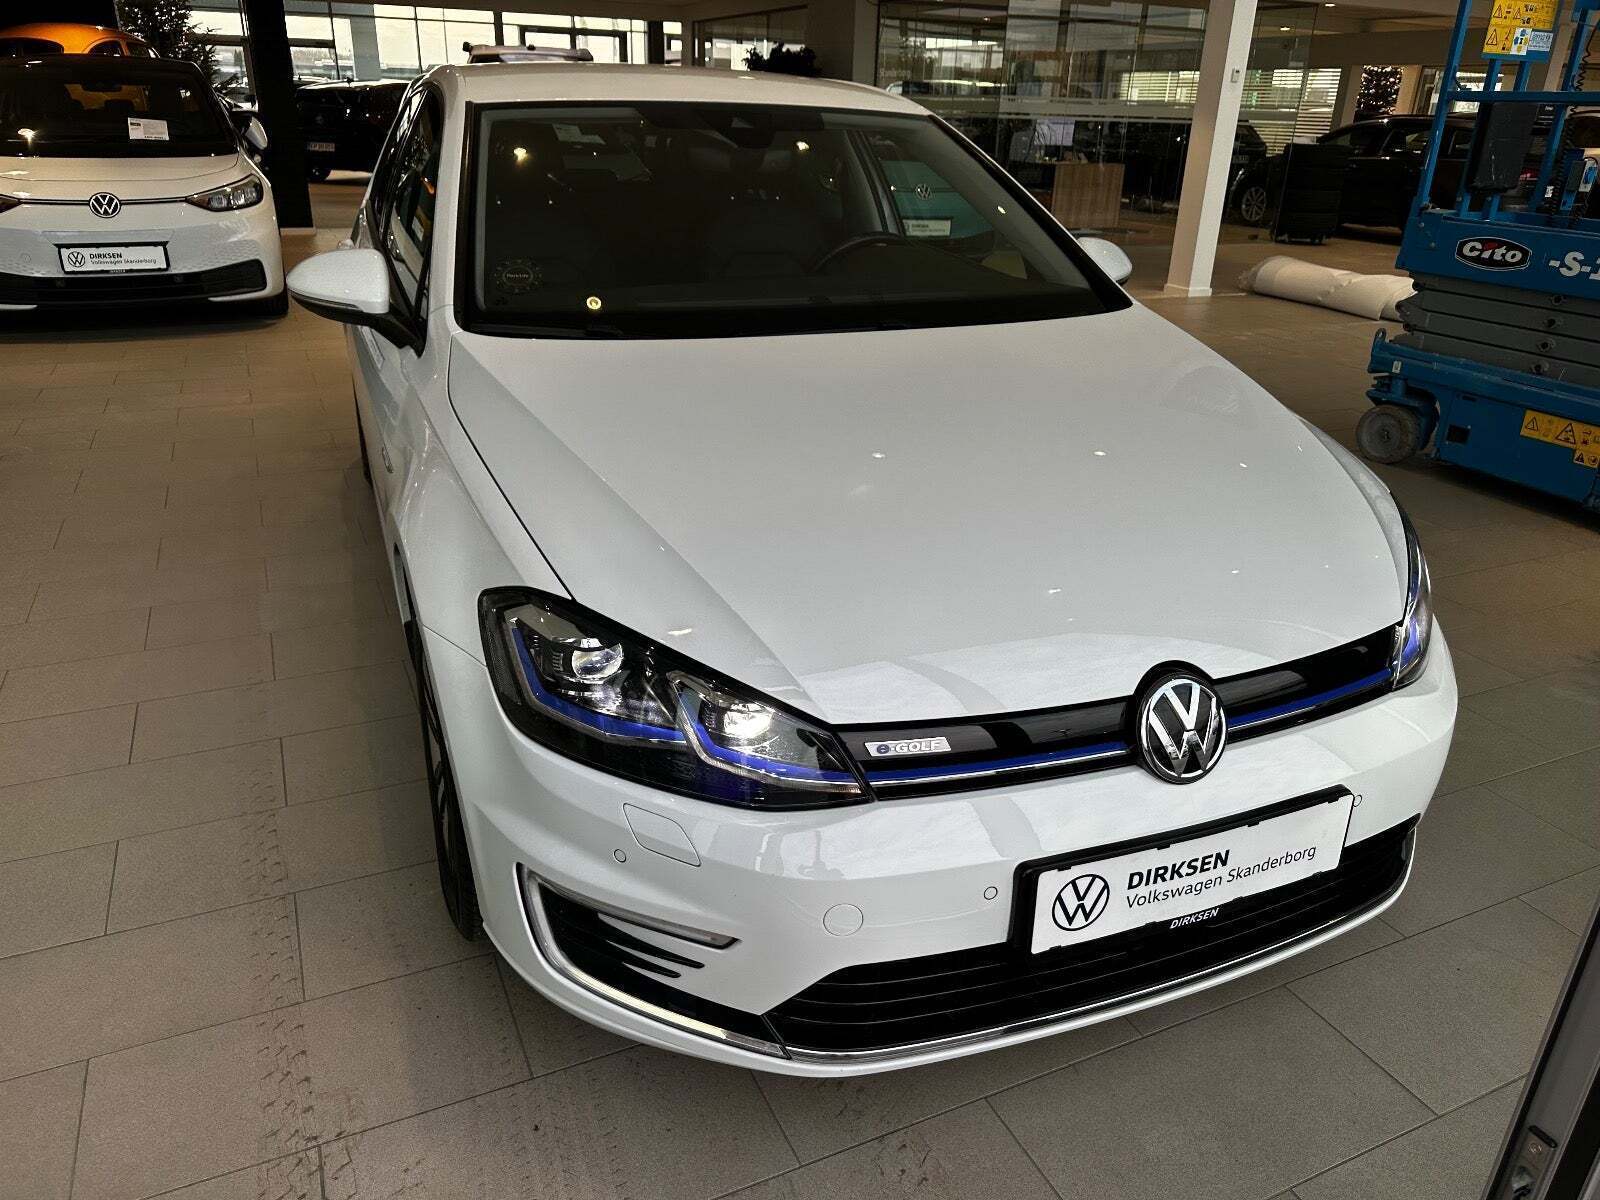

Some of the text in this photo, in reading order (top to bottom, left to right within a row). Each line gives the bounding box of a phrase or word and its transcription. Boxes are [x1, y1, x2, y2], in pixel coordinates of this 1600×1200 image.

[89, 192, 121, 218] VW
[67, 251, 86, 268] VW
[89, 252, 123, 260] DIRKSEN
[1462, 241, 1523, 263] Cito
[1140, 677, 1227, 780] VW
[1126, 845, 1317, 909] Volkswagen Skanderborg
[1127, 849, 1230, 891] DIRKSEN
[1051, 873, 1111, 932] VW
[1169, 907, 1220, 929] DIRKSEN
